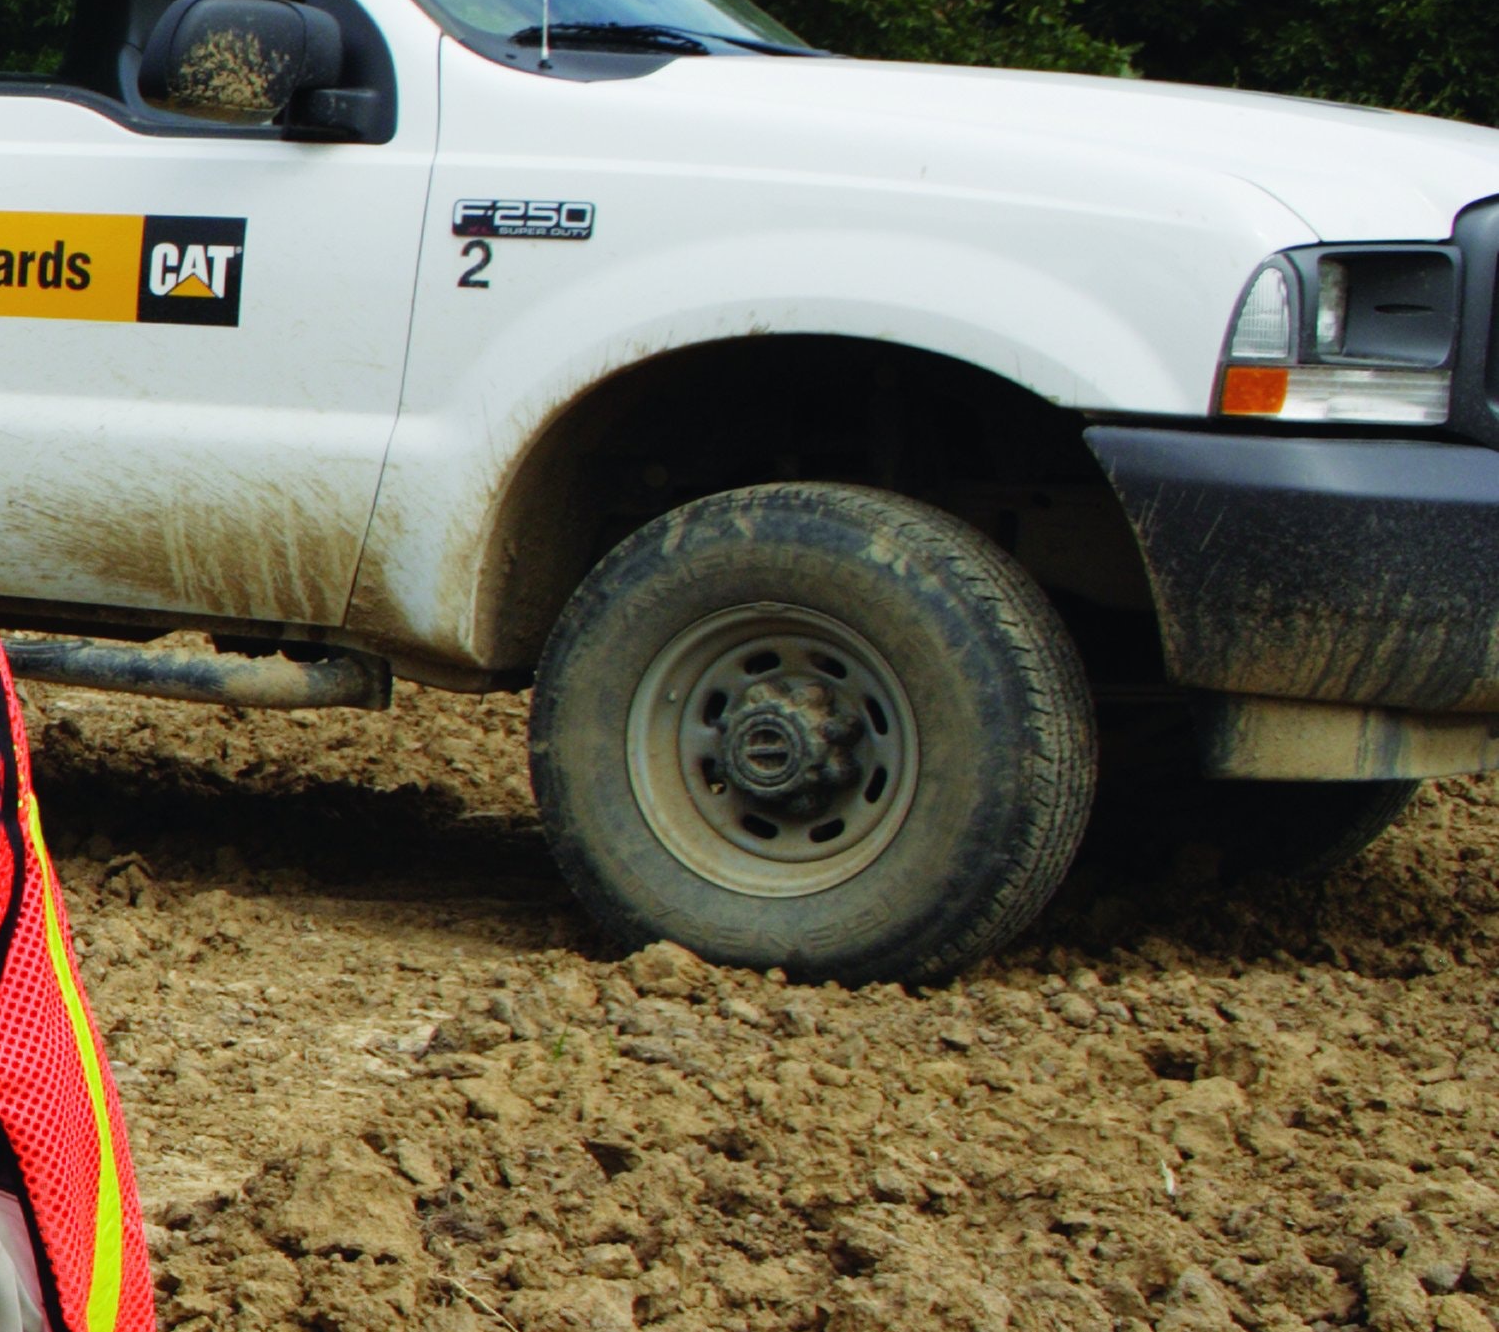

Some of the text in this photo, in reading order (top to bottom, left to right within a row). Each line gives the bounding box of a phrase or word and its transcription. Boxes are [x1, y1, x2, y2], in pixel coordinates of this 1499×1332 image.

[498, 226, 547, 236] SUPER
[550, 228, 590, 238] DUTY
[148, 241, 237, 299] CAT
[457, 239, 492, 289] 2
